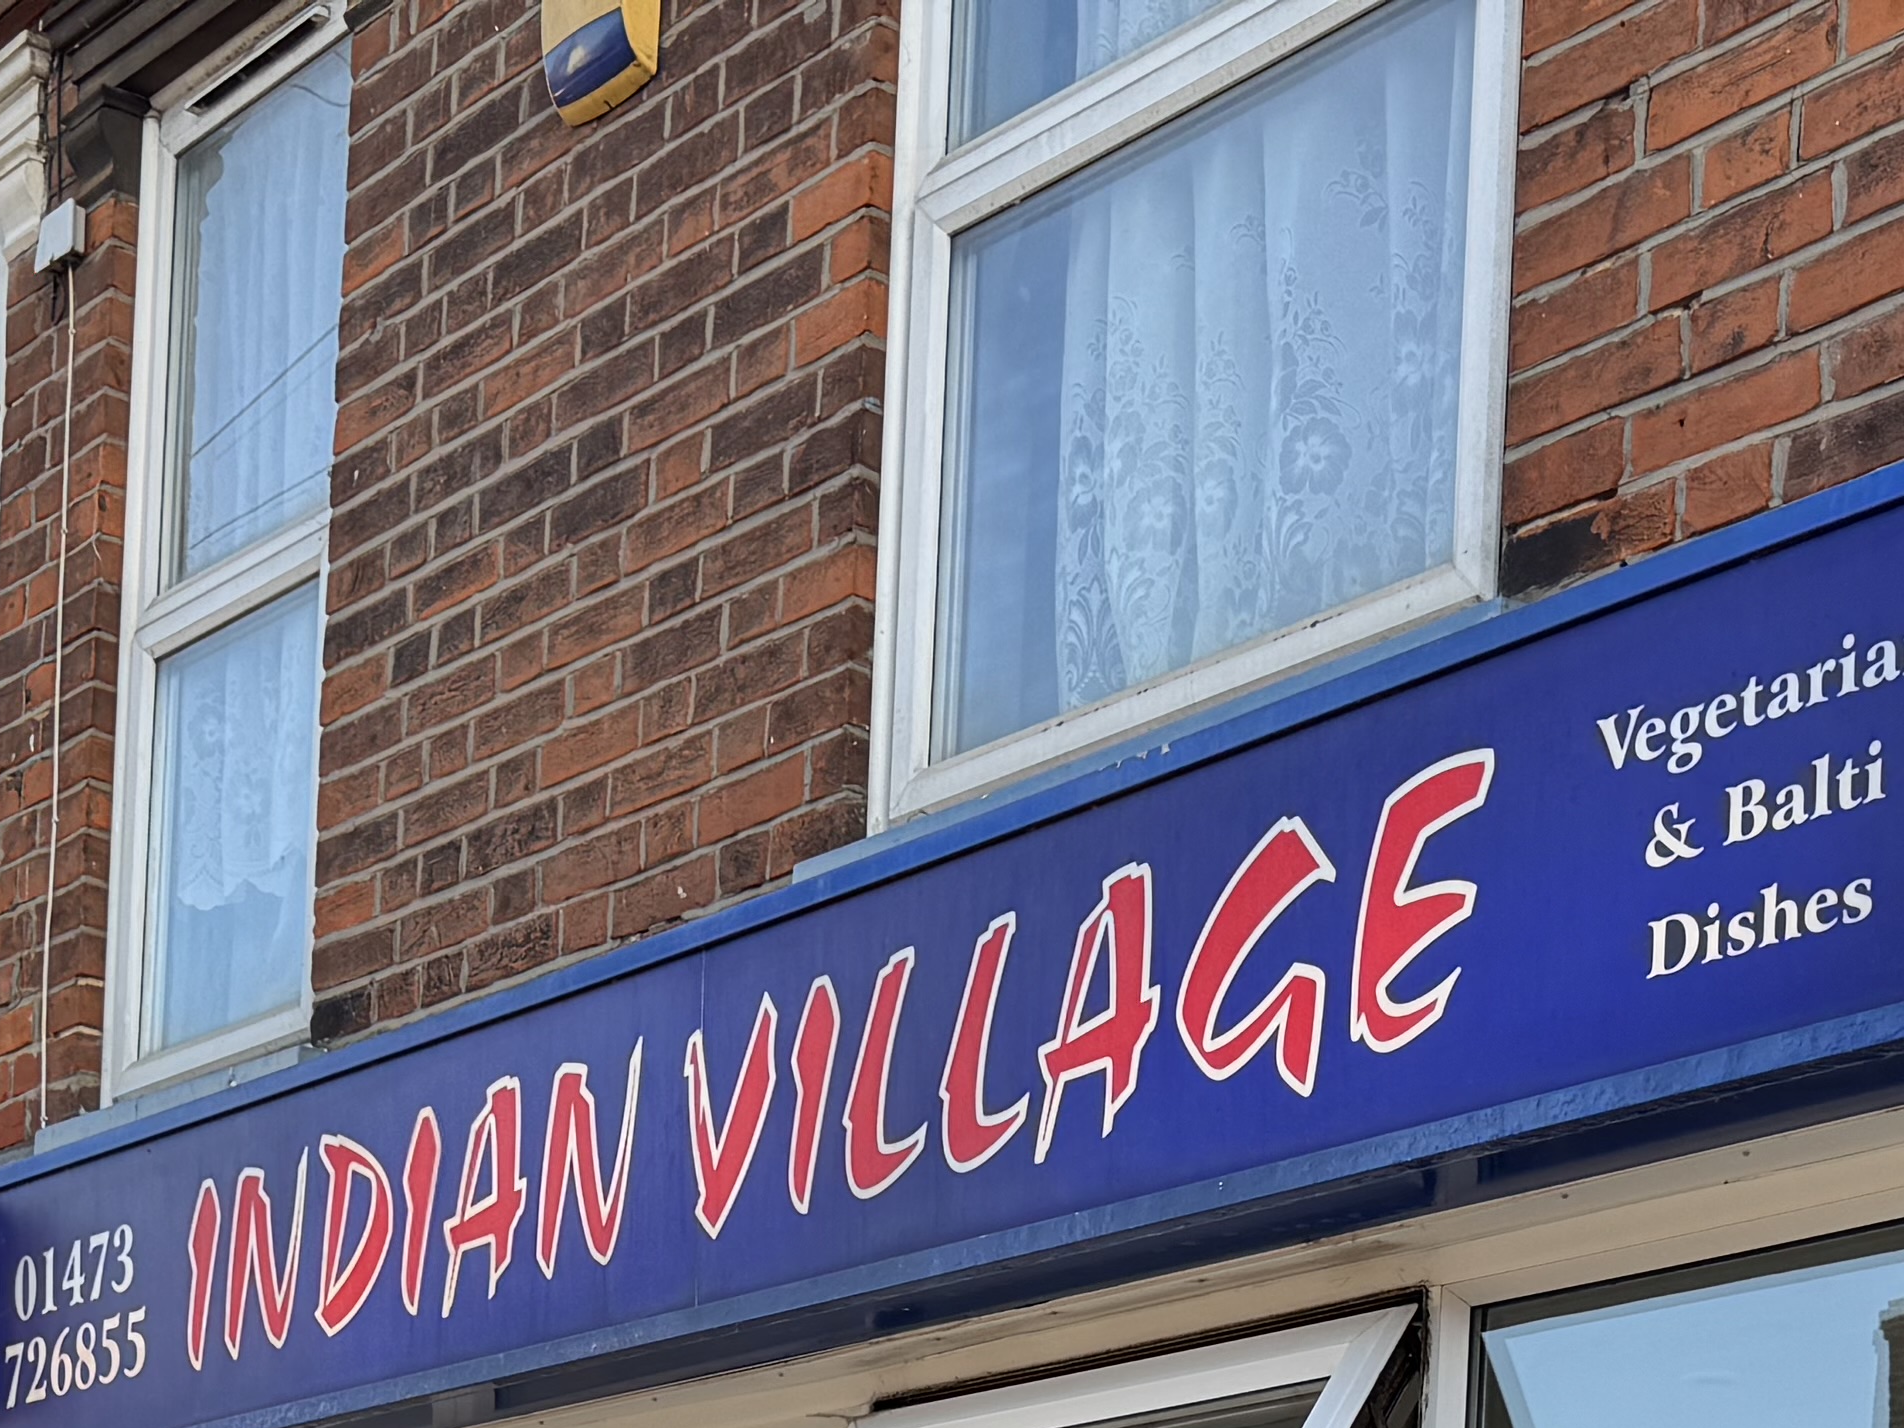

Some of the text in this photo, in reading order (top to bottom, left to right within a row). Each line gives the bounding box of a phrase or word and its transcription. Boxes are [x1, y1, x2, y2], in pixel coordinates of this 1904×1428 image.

[1645, 740, 1888, 871] & Balti
[1645, 877, 1876, 982] Dishes
[187, 748, 1497, 1370] INDIAN VILLAGE
[14, 1224, 135, 1321] 01473
[4, 1306, 147, 1410] 726855
